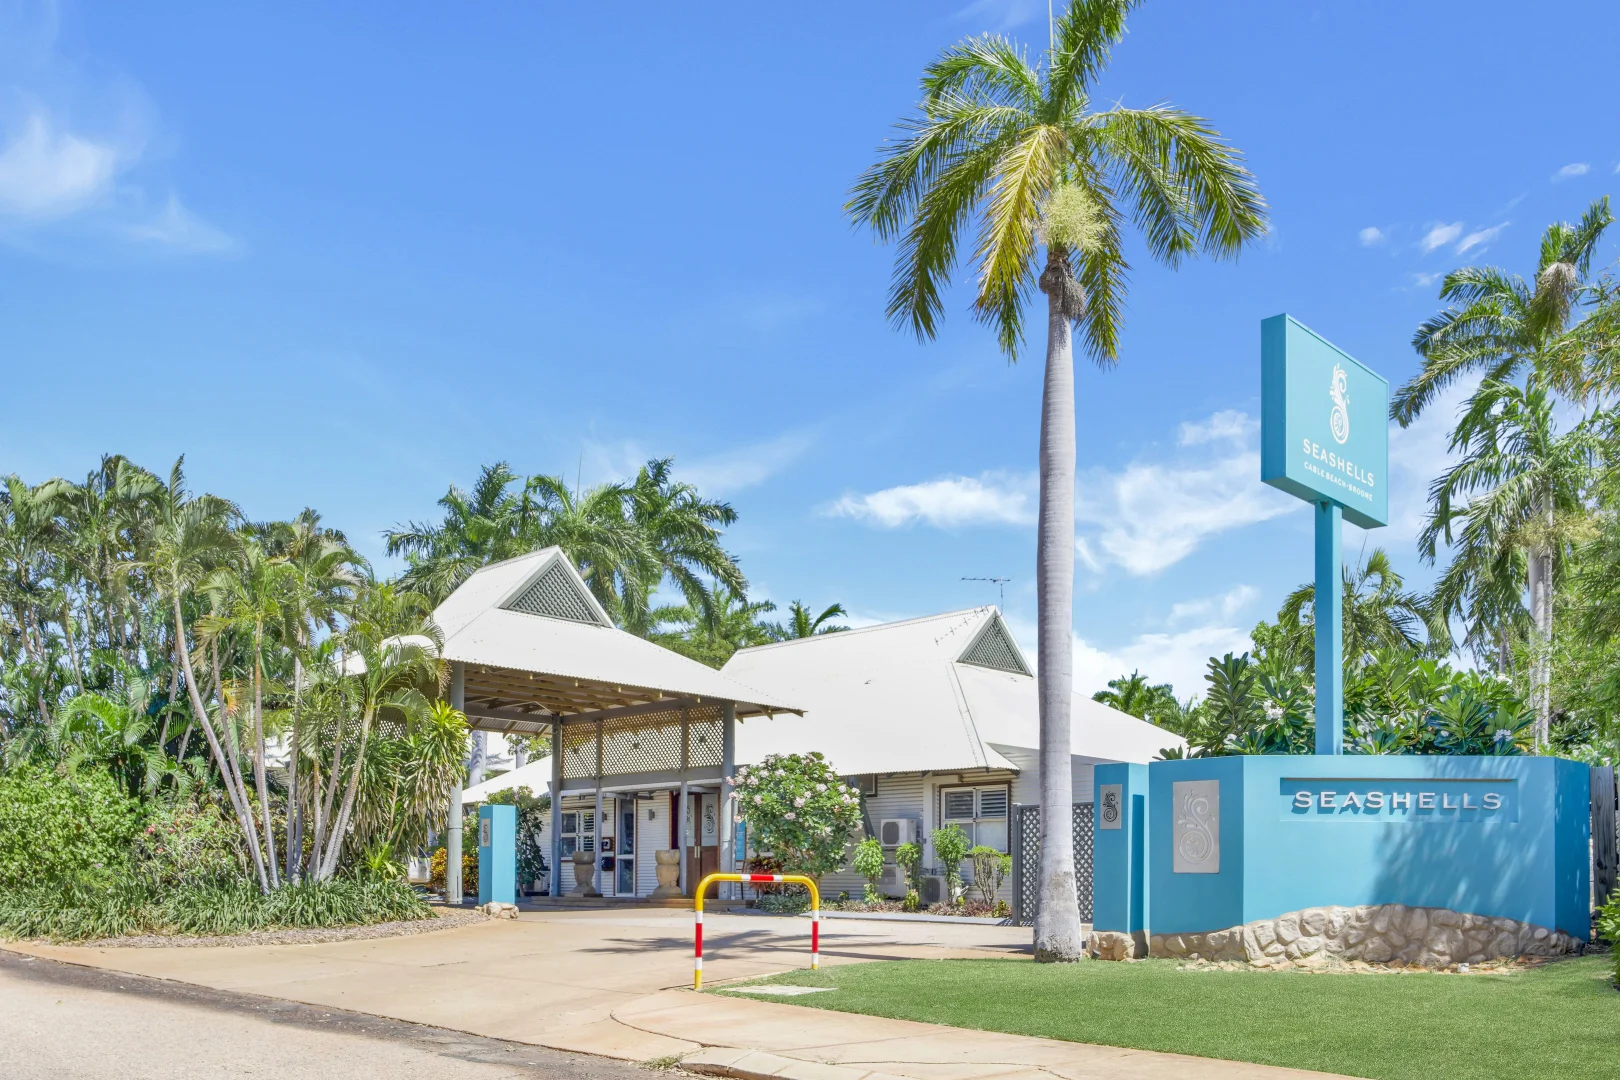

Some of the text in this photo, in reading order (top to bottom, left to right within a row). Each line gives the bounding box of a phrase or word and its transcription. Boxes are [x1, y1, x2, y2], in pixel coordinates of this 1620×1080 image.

[1303, 438, 1374, 487] SEASHELLS
[1304, 461, 1325, 478] CABLE
[1294, 791, 1502, 810] SEASHELLS
